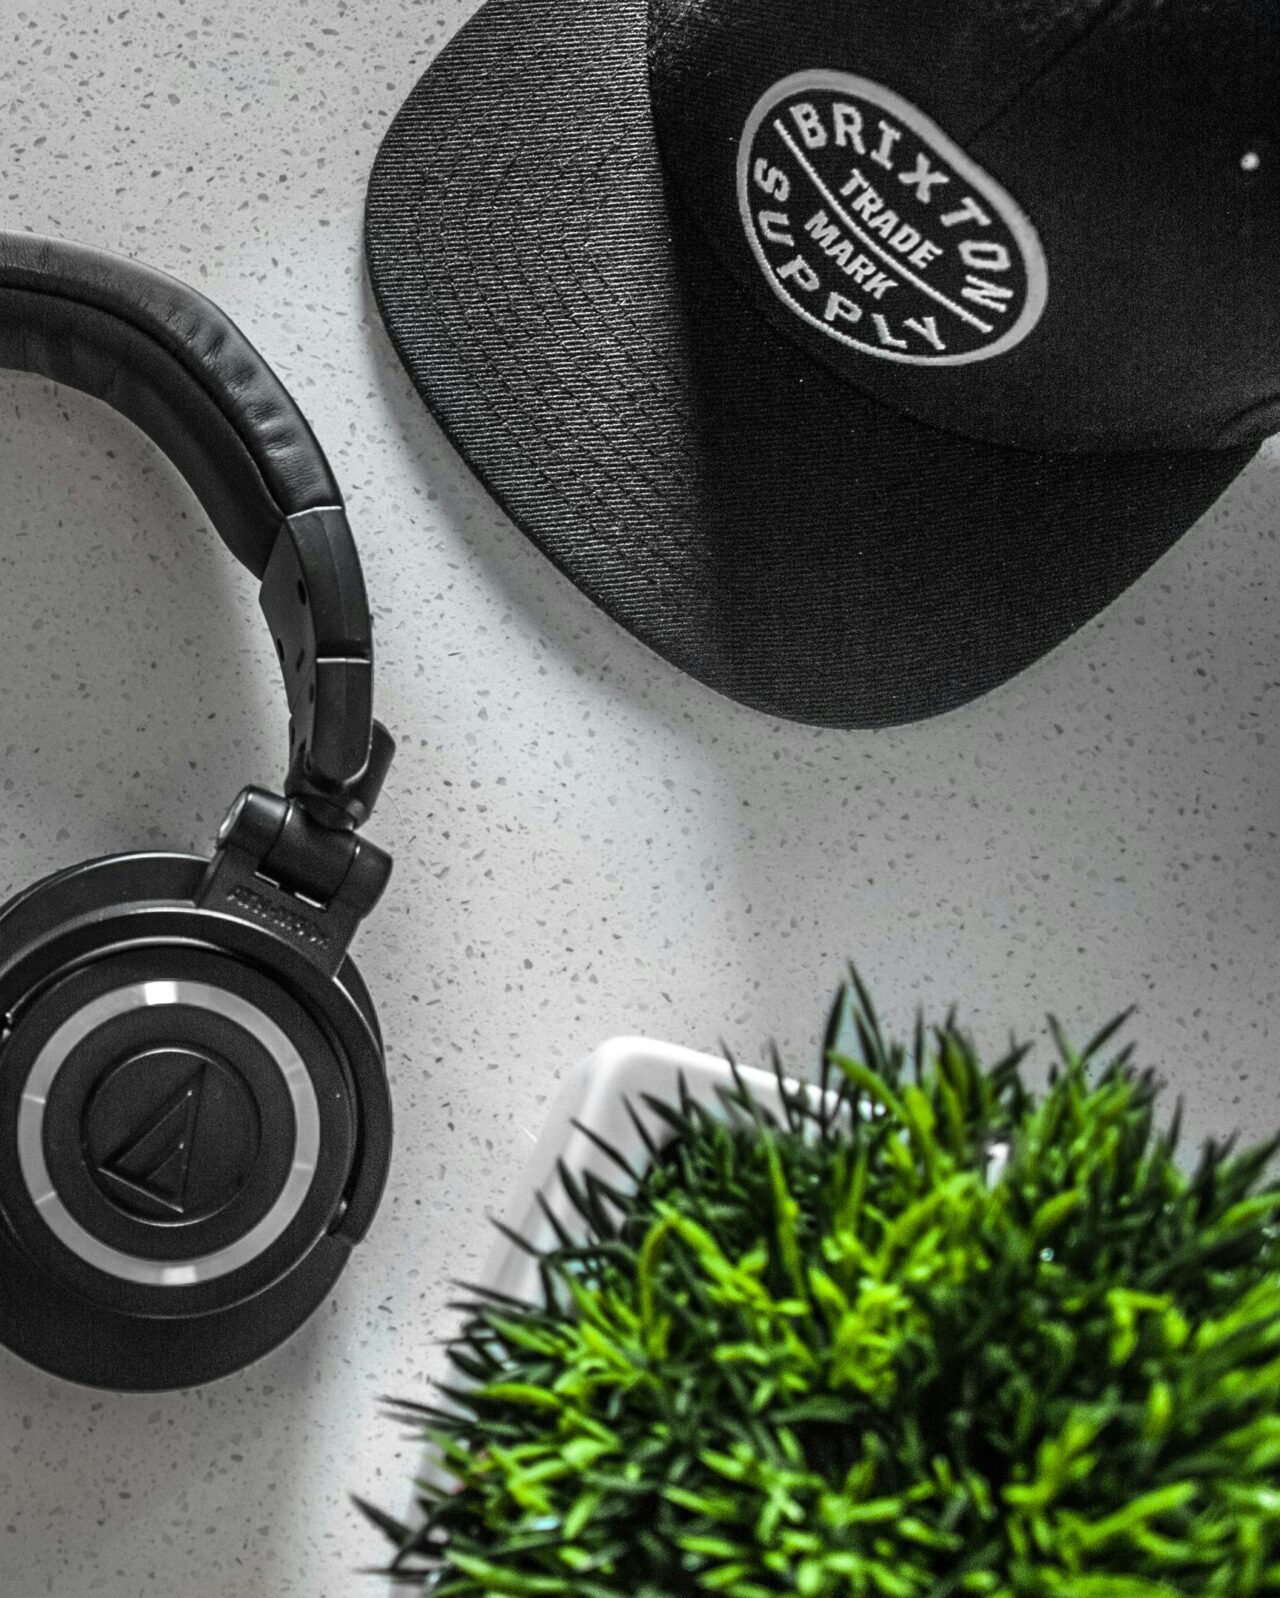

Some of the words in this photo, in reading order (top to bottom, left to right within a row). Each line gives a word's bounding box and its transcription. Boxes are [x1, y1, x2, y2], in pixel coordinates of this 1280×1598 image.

[753, 157, 947, 350] SUPPLY
[788, 101, 1014, 313] BRIXTON
[804, 209, 898, 300] MARK
[839, 167, 944, 270] TRADE
